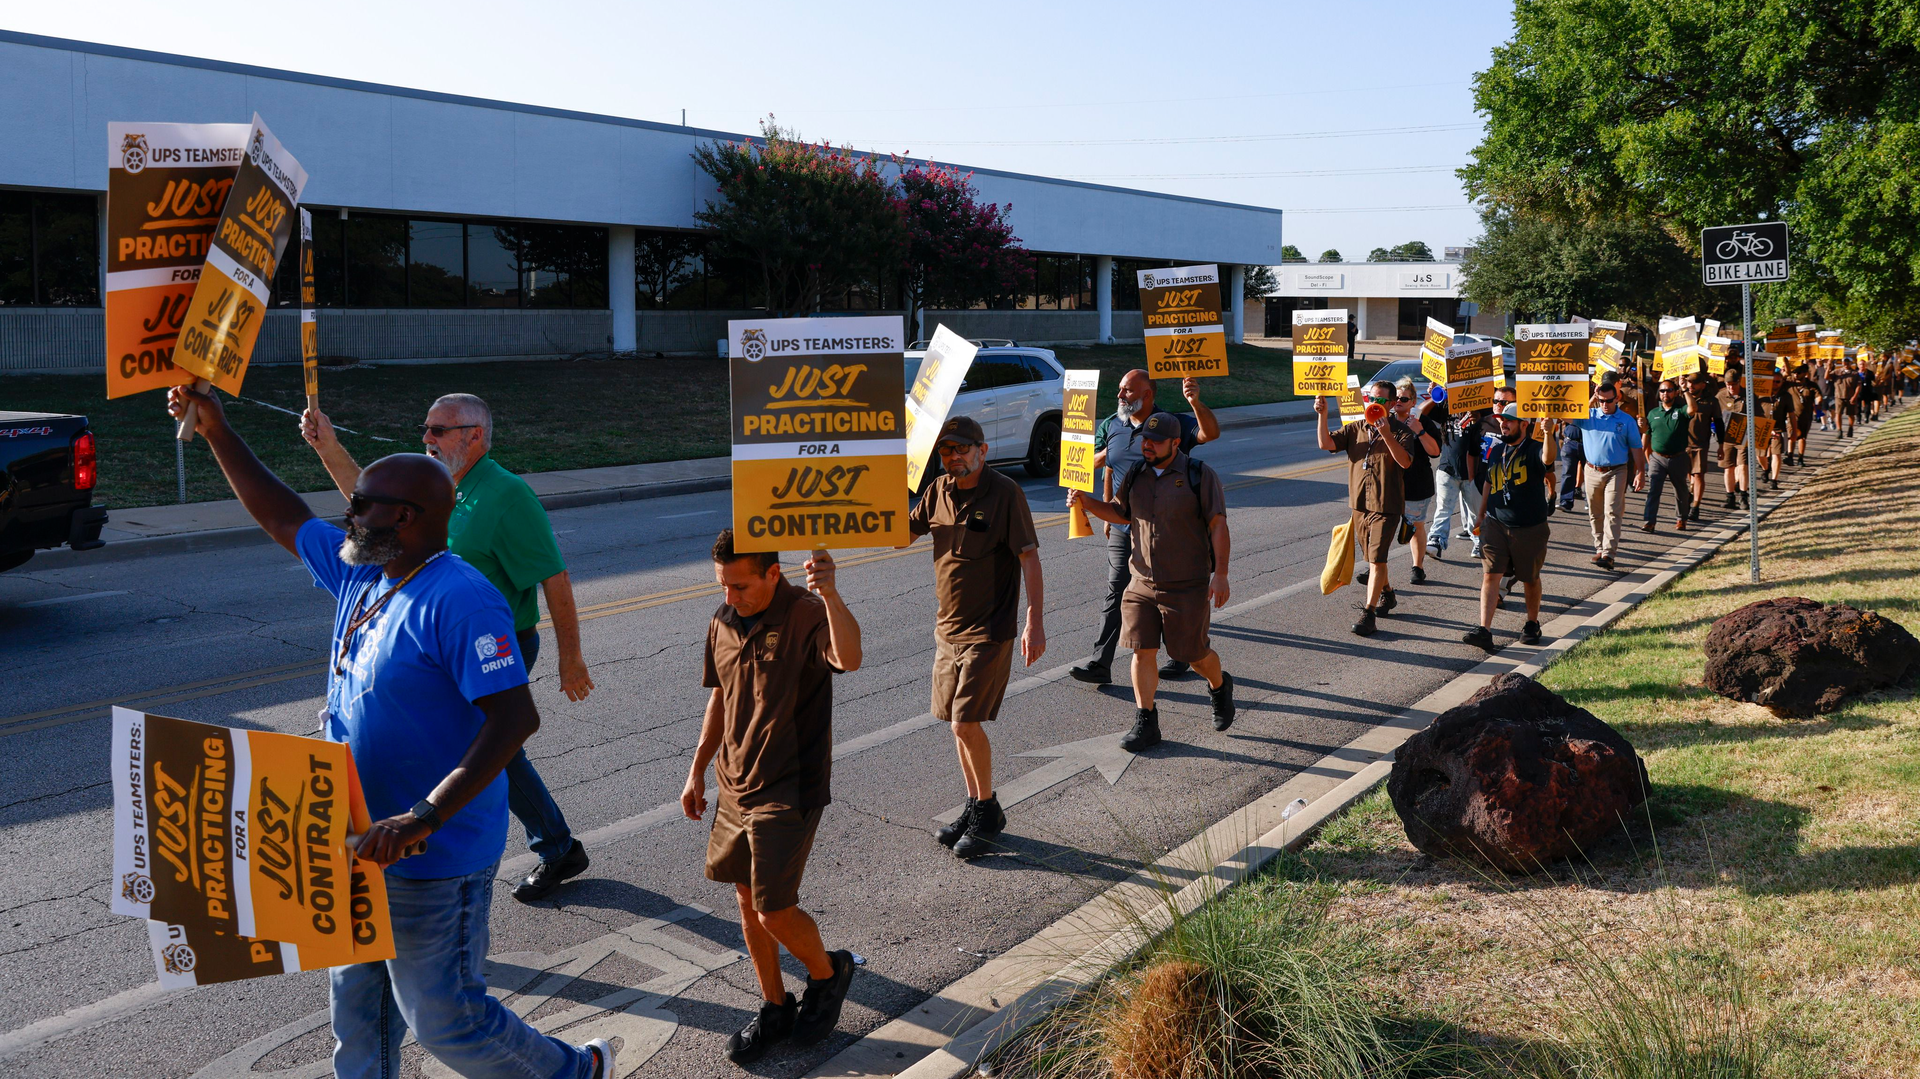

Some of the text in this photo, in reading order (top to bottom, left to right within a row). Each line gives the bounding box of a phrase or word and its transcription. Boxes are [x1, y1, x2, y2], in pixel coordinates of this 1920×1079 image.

[152, 148, 181, 163] UPS
[261, 150, 273, 171] UPS
[147, 178, 233, 218] JUST
[246, 185, 287, 233] JUST
[171, 269, 200, 282] FOR
[233, 267, 255, 289] FOR A
[1413, 274, 1418, 282] J
[1426, 274, 1433, 282] S
[1708, 262, 1783, 280] BIKE LANE
[1171, 275, 1214, 285] TEAMSTERS:
[1157, 288, 1202, 308] JUST
[208, 287, 255, 333] JUST
[1147, 311, 1218, 325] PRACTICING
[1303, 327, 1336, 340] JUST
[1430, 332, 1447, 345] JUST
[1596, 328, 1618, 336] JUST
[1667, 329, 1689, 342] JUST
[770, 337, 895, 352] UPS TEAMSTERS:
[1164, 337, 1208, 354] JUST
[1296, 344, 1344, 353] PRACTICING
[1531, 343, 1573, 357] JUST
[183, 326, 244, 379] CONTRACT
[1669, 352, 1690, 365] JUST
[1154, 359, 1221, 373] CONTRACT
[1426, 358, 1443, 370] JUST
[1456, 355, 1483, 369] JUST
[1520, 362, 1585, 371] PRACTICING
[1667, 363, 1697, 375] CONTRACT
[1304, 364, 1336, 377] JUST
[1423, 367, 1446, 383] CONTRACT
[1449, 368, 1491, 381] PRACTICING
[768, 363, 868, 399] JUST
[1298, 382, 1344, 391] CONTRACT
[1457, 385, 1484, 398] JUST
[1531, 384, 1573, 398] JUST
[1068, 393, 1089, 411] JUST
[1452, 397, 1492, 410] CONTRACT
[1522, 403, 1584, 413] CONTRACT
[743, 410, 895, 436] PRACTICING
[1063, 417, 1093, 431] PRACTICING
[798, 443, 840, 455] FOR A
[1066, 445, 1086, 463] JUST
[771, 464, 870, 499] JUST
[1062, 468, 1091, 485] CONTRACT
[747, 510, 896, 538] CONTRACT
[425, 553, 440, 564] GAME
[481, 655, 515, 674] DRIVE
[129, 722, 146, 869] UPS TEAMSTERS:
[153, 760, 189, 883] JUST
[202, 737, 230, 919] PRACTICING
[235, 810, 247, 861] FOR A
[257, 776, 293, 900] JUST
[305, 754, 337, 935] CONTRACT
[350, 857, 377, 945] CON
